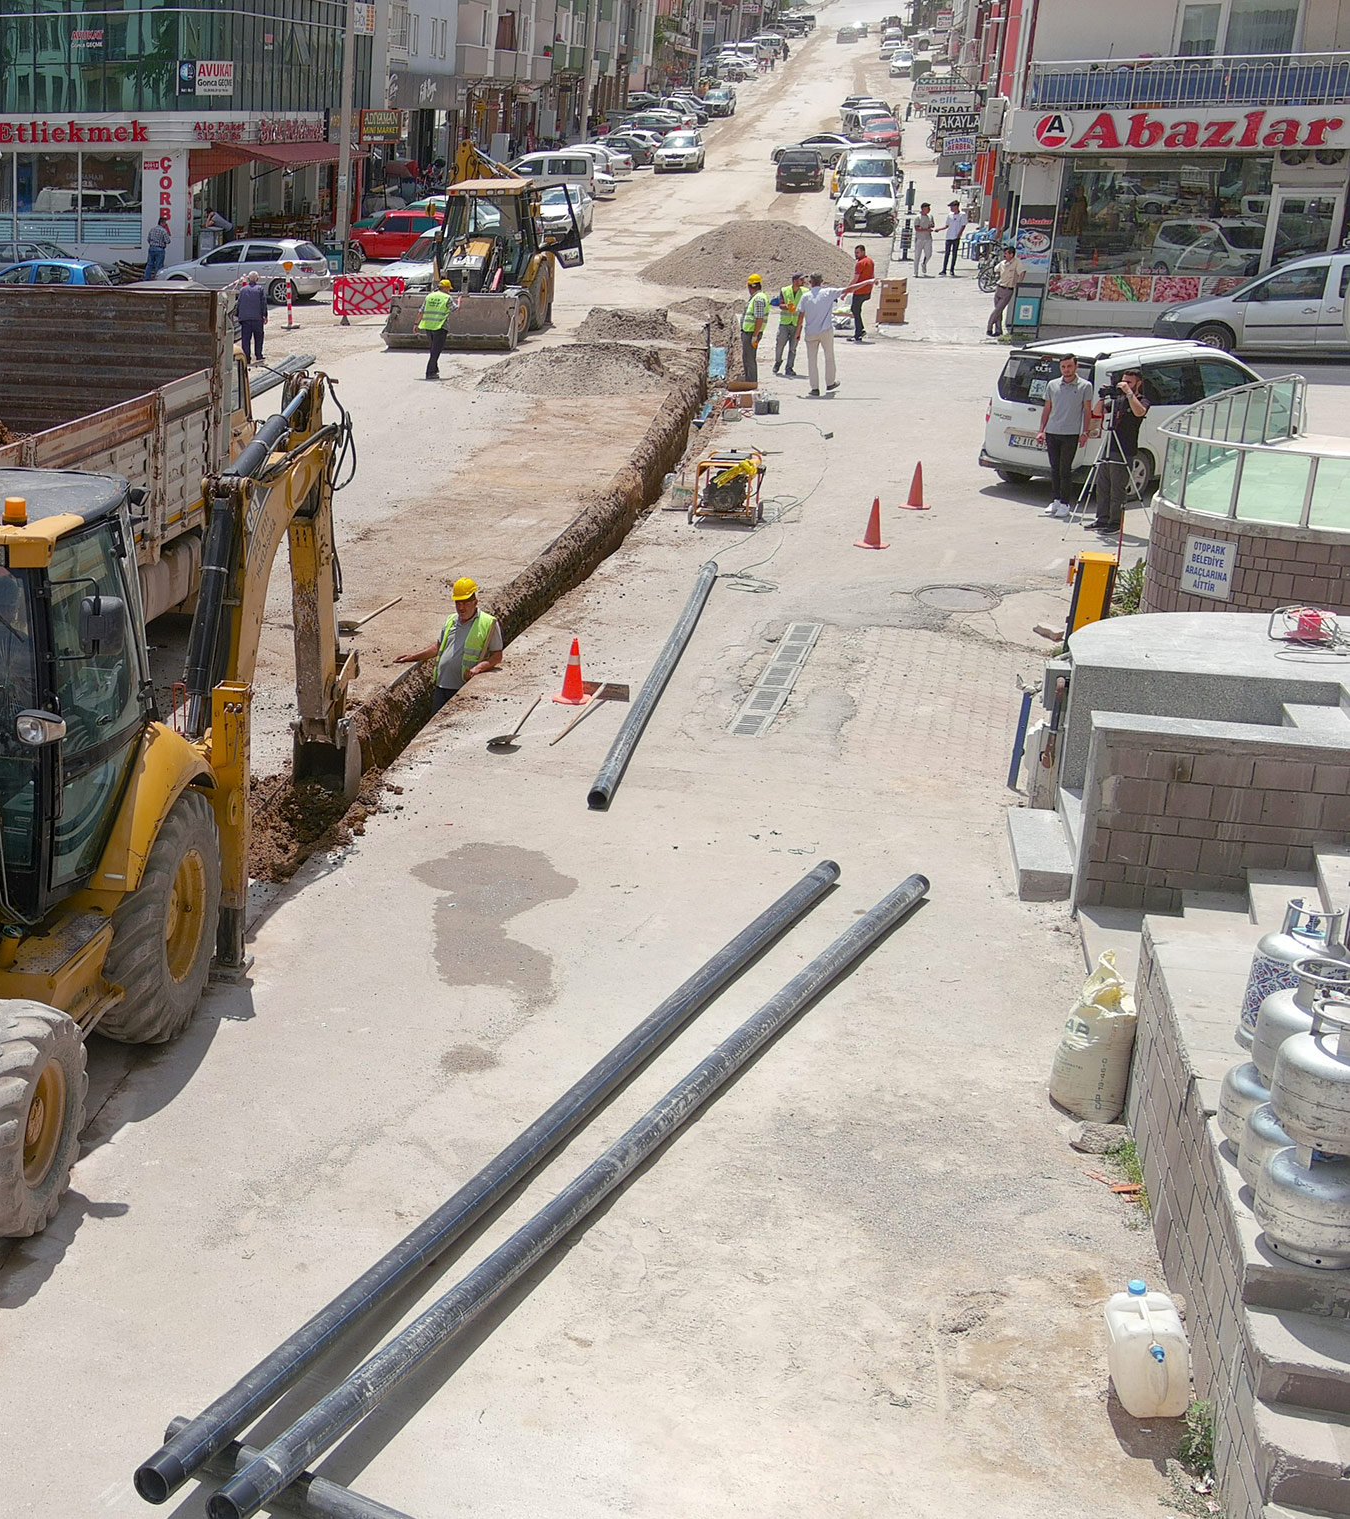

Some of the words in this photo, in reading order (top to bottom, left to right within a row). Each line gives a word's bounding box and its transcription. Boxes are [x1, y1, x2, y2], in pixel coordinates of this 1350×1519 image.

[71, 30, 104, 40] AVUKAT
[198, 63, 232, 77] AVUKAT
[197, 79, 217, 87] Gonca
[193, 122, 214, 131] Alo
[218, 121, 246, 131] Paket
[377, 126, 399, 134] MARKET
[1045, 115, 1065, 133] A
[1071, 110, 1344, 149] Abazlar
[197, 132, 215, 141] 512
[452, 255, 480, 265] CAT
[1194, 541, 1226, 556] OTOPARK
[1191, 553, 1225, 569] BELEDİYE
[1185, 565, 1228, 582] ARAÇLARINA
